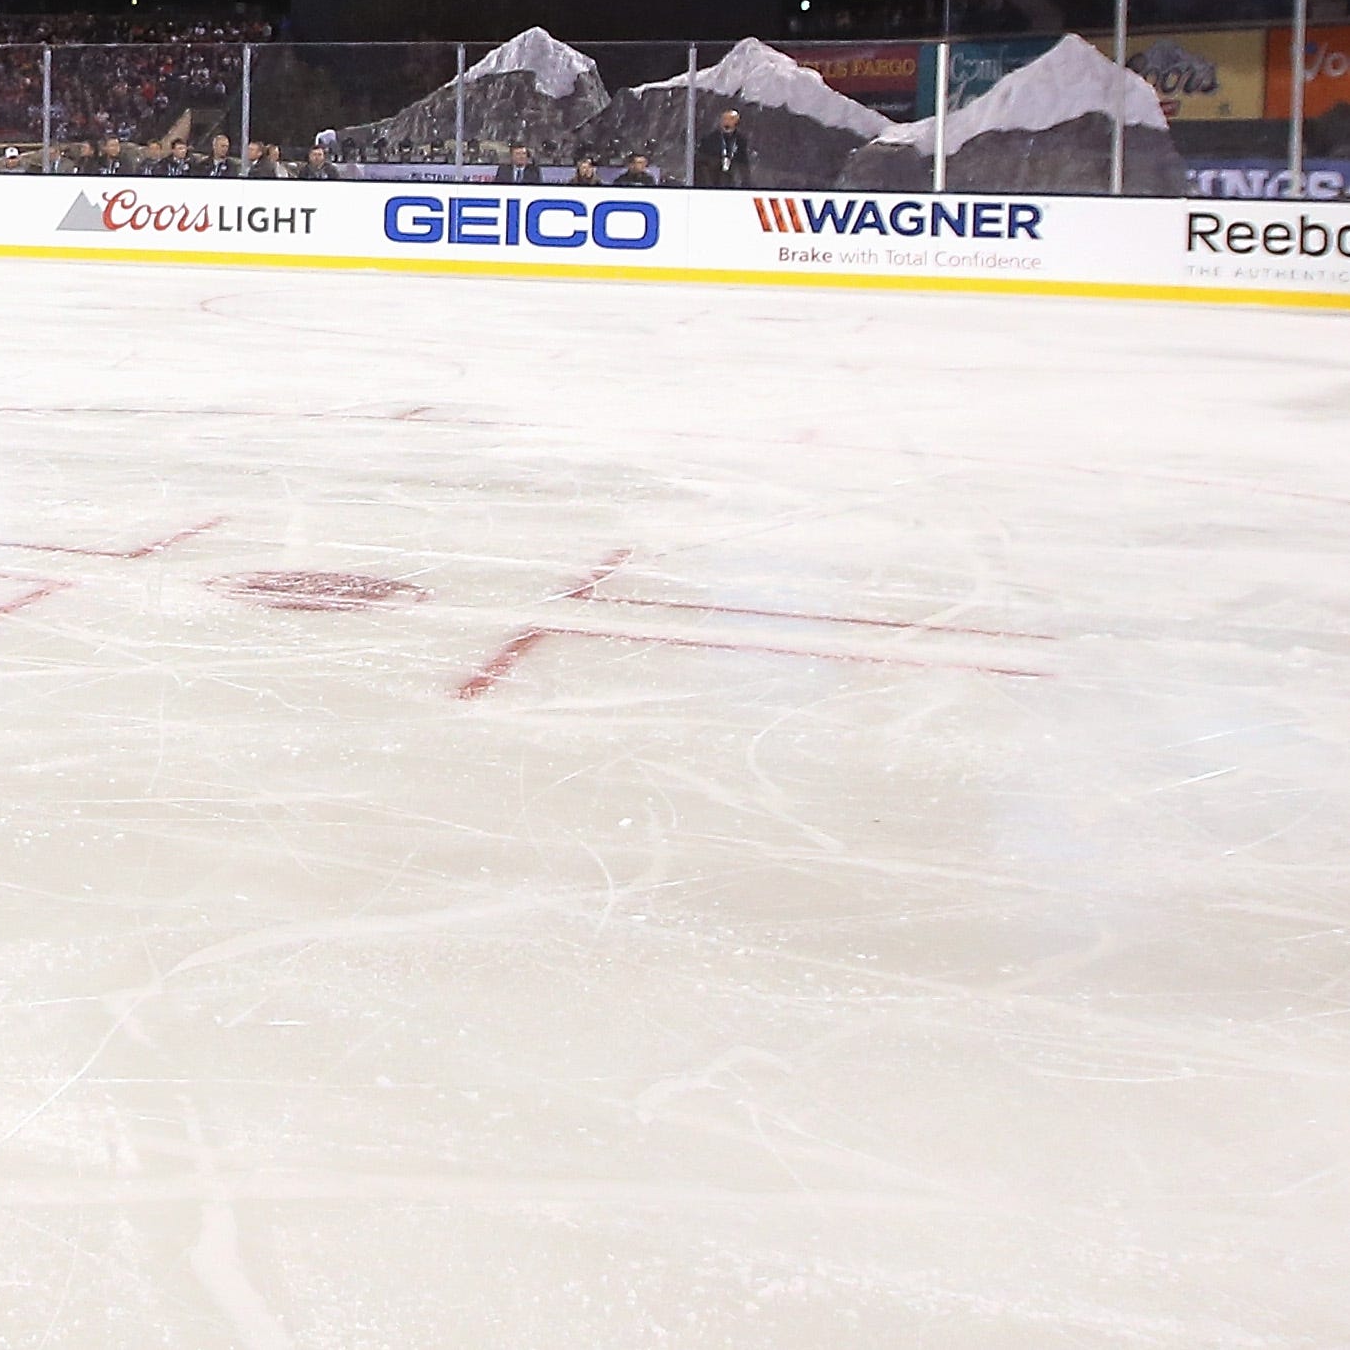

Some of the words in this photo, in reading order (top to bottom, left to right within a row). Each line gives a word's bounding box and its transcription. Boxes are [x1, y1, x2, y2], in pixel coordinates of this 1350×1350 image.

[102, 189, 214, 233] Coors
[217, 206, 318, 234] LIGHT
[383, 195, 661, 250] GEICO
[801, 199, 1043, 239] WAGNER
[778, 247, 833, 263] Brake
[839, 249, 879, 265] with
[885, 250, 928, 267] Total
[934, 251, 1043, 270] Confidence
